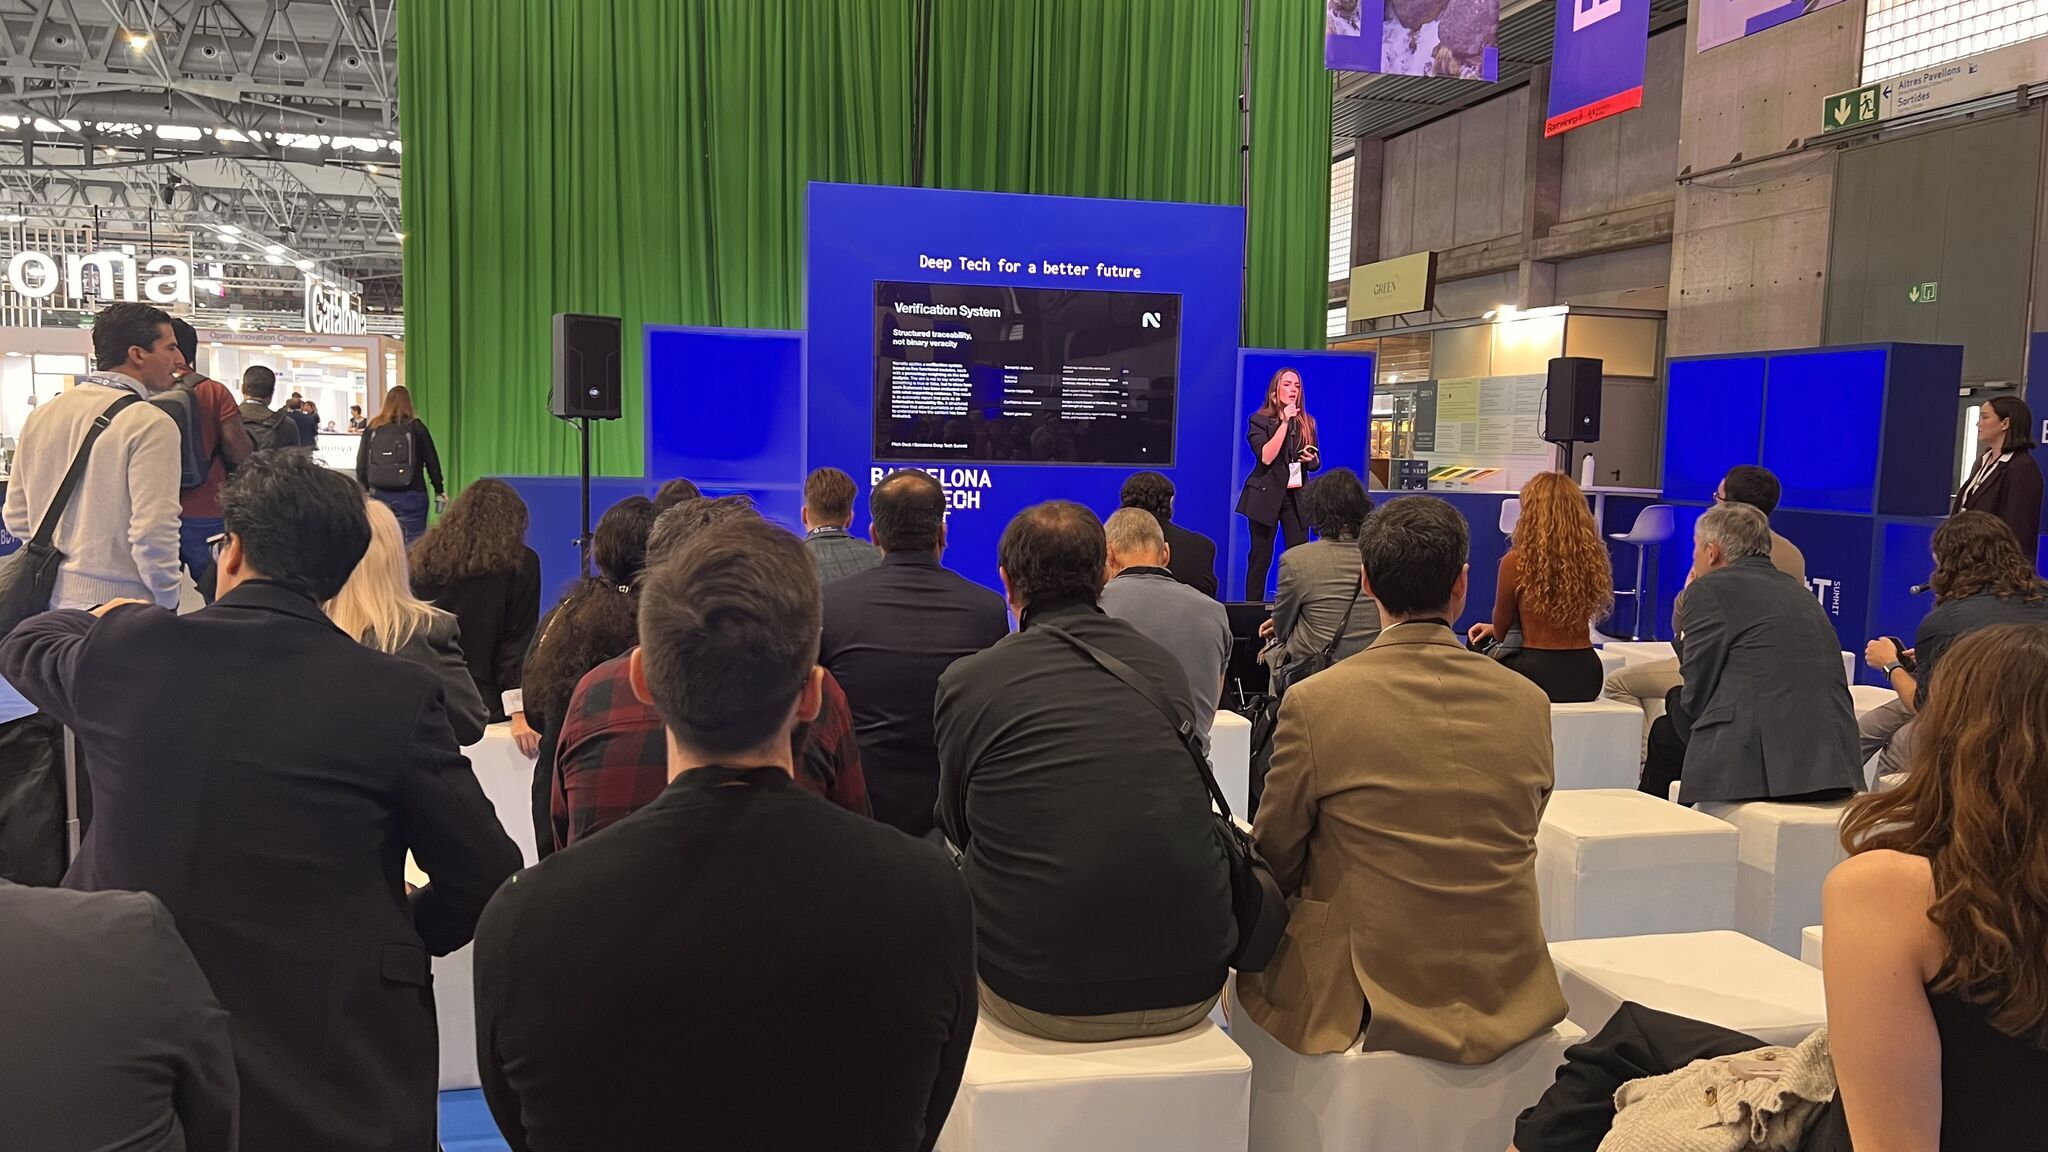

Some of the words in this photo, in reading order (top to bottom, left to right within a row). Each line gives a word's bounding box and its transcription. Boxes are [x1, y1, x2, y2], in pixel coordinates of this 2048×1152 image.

[1898, 78, 1922, 89] Altres
[1897, 92, 1930, 107] Sortides
[919, 254, 952, 272] Deep
[958, 256, 991, 272] Tech
[997, 258, 1021, 273] for
[1028, 262, 1037, 274] a
[1043, 260, 1089, 276] better
[1096, 263, 1141, 278] future
[894, 301, 957, 316] Verification
[959, 304, 1001, 318] System
[210, 332, 232, 341] Open
[892, 328, 931, 338] Structured
[931, 330, 973, 341] traceability,
[906, 339, 929, 348] binary
[1832, 580, 1841, 616] SUMMIT
